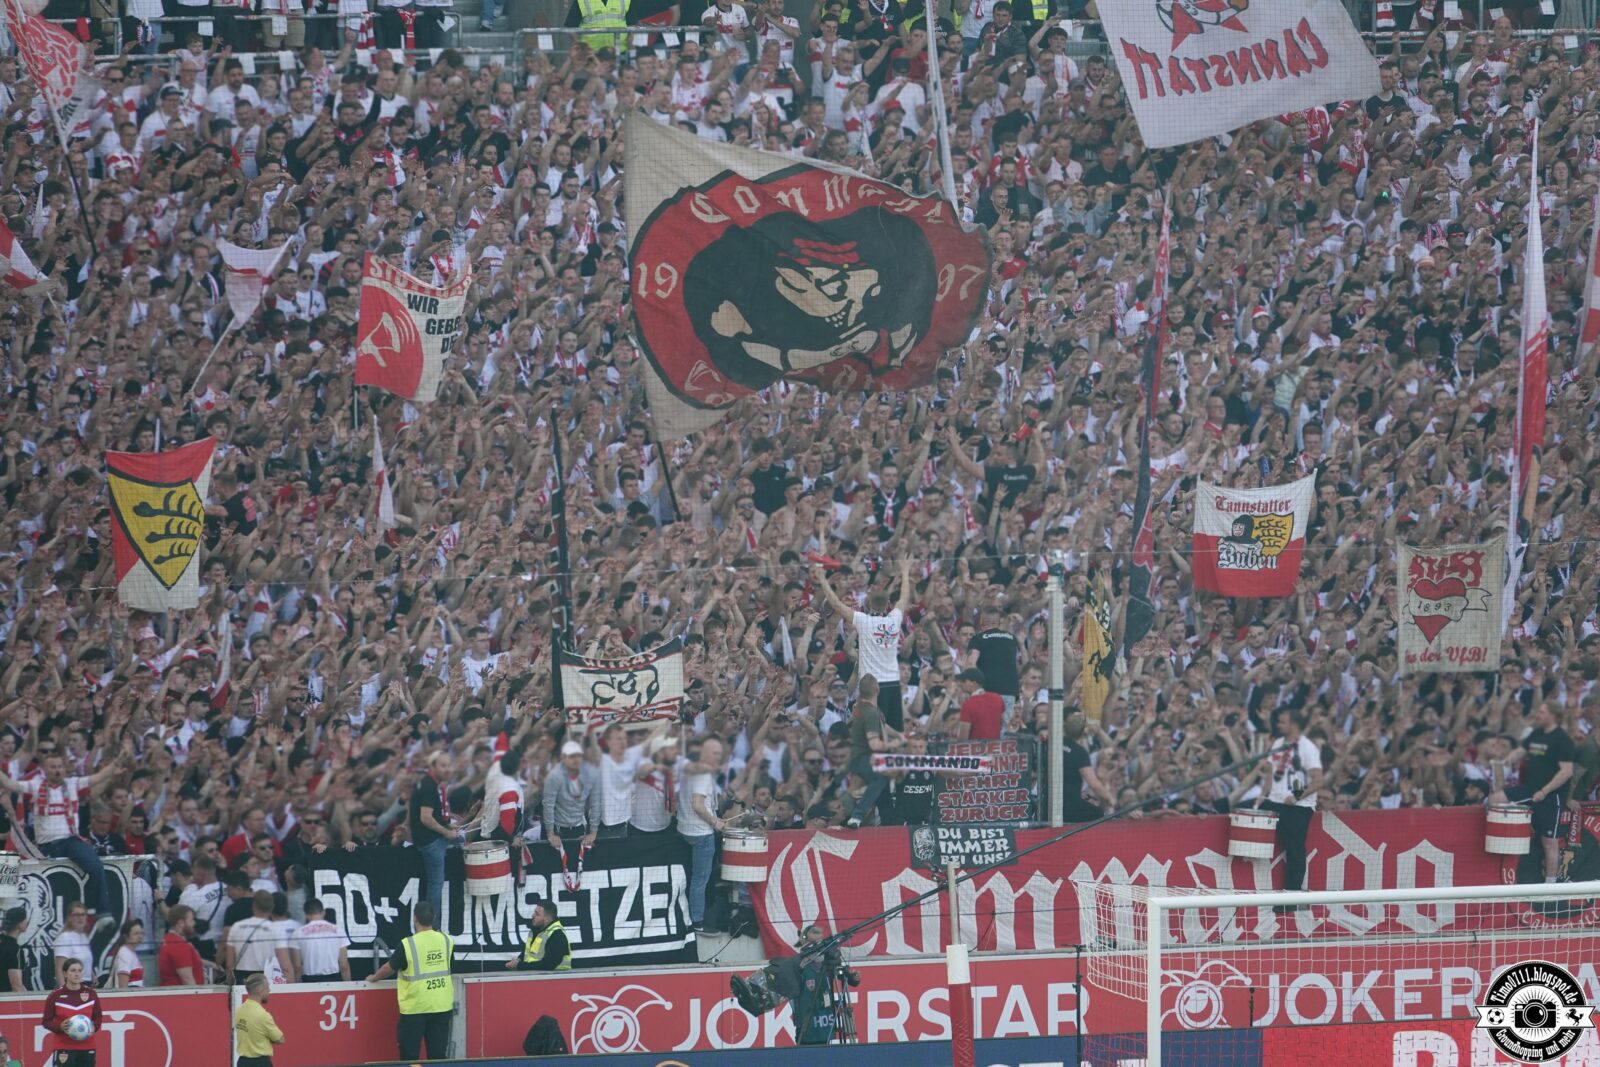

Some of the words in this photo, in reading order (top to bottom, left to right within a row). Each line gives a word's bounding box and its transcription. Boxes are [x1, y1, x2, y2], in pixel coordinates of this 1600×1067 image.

[639, 262, 679, 299] 19
[937, 263, 986, 301] 97
[407, 293, 440, 314] WIR
[1217, 543, 1277, 569] Buben
[1418, 600, 1452, 613] 1893
[1447, 646, 1488, 666] VfB!
[945, 740, 1018, 756] JEDER
[885, 756, 980, 770] COMMANDO
[946, 774, 1021, 791] KEHRT
[938, 789, 1031, 808] STÄRKER
[940, 804, 1029, 823] ZURÜCK
[938, 828, 962, 840] DU
[968, 828, 1006, 839] BIST
[938, 839, 1010, 855] IMMER
[941, 854, 966, 866] BEI
[313, 868, 420, 944] 50+1
[437, 863, 694, 947] UMSETZEN
[427, 951, 443, 962] SDS
[426, 978, 446, 991] 2536
[319, 994, 359, 1031] 34
[673, 983, 1091, 1052] JOKRSTAR
